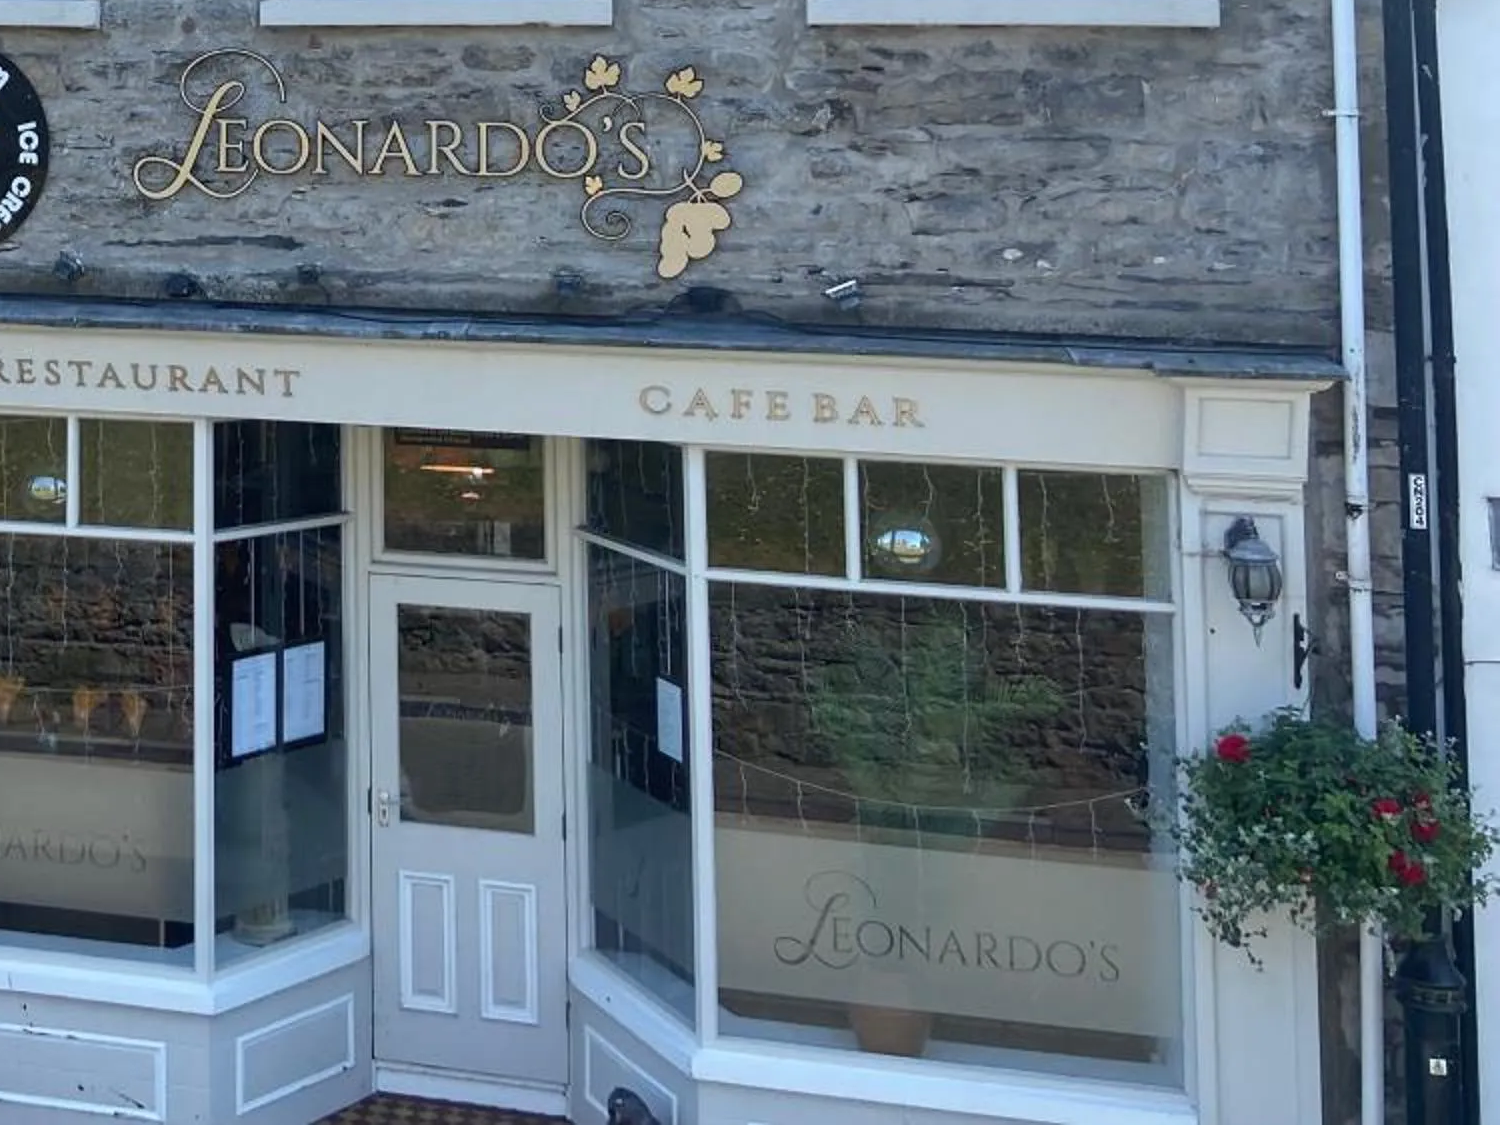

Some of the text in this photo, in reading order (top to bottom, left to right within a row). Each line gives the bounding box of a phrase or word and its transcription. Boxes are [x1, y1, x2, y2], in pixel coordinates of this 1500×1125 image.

[17, 120, 40, 166] ICE
[638, 385, 927, 428] CAFE BAR
